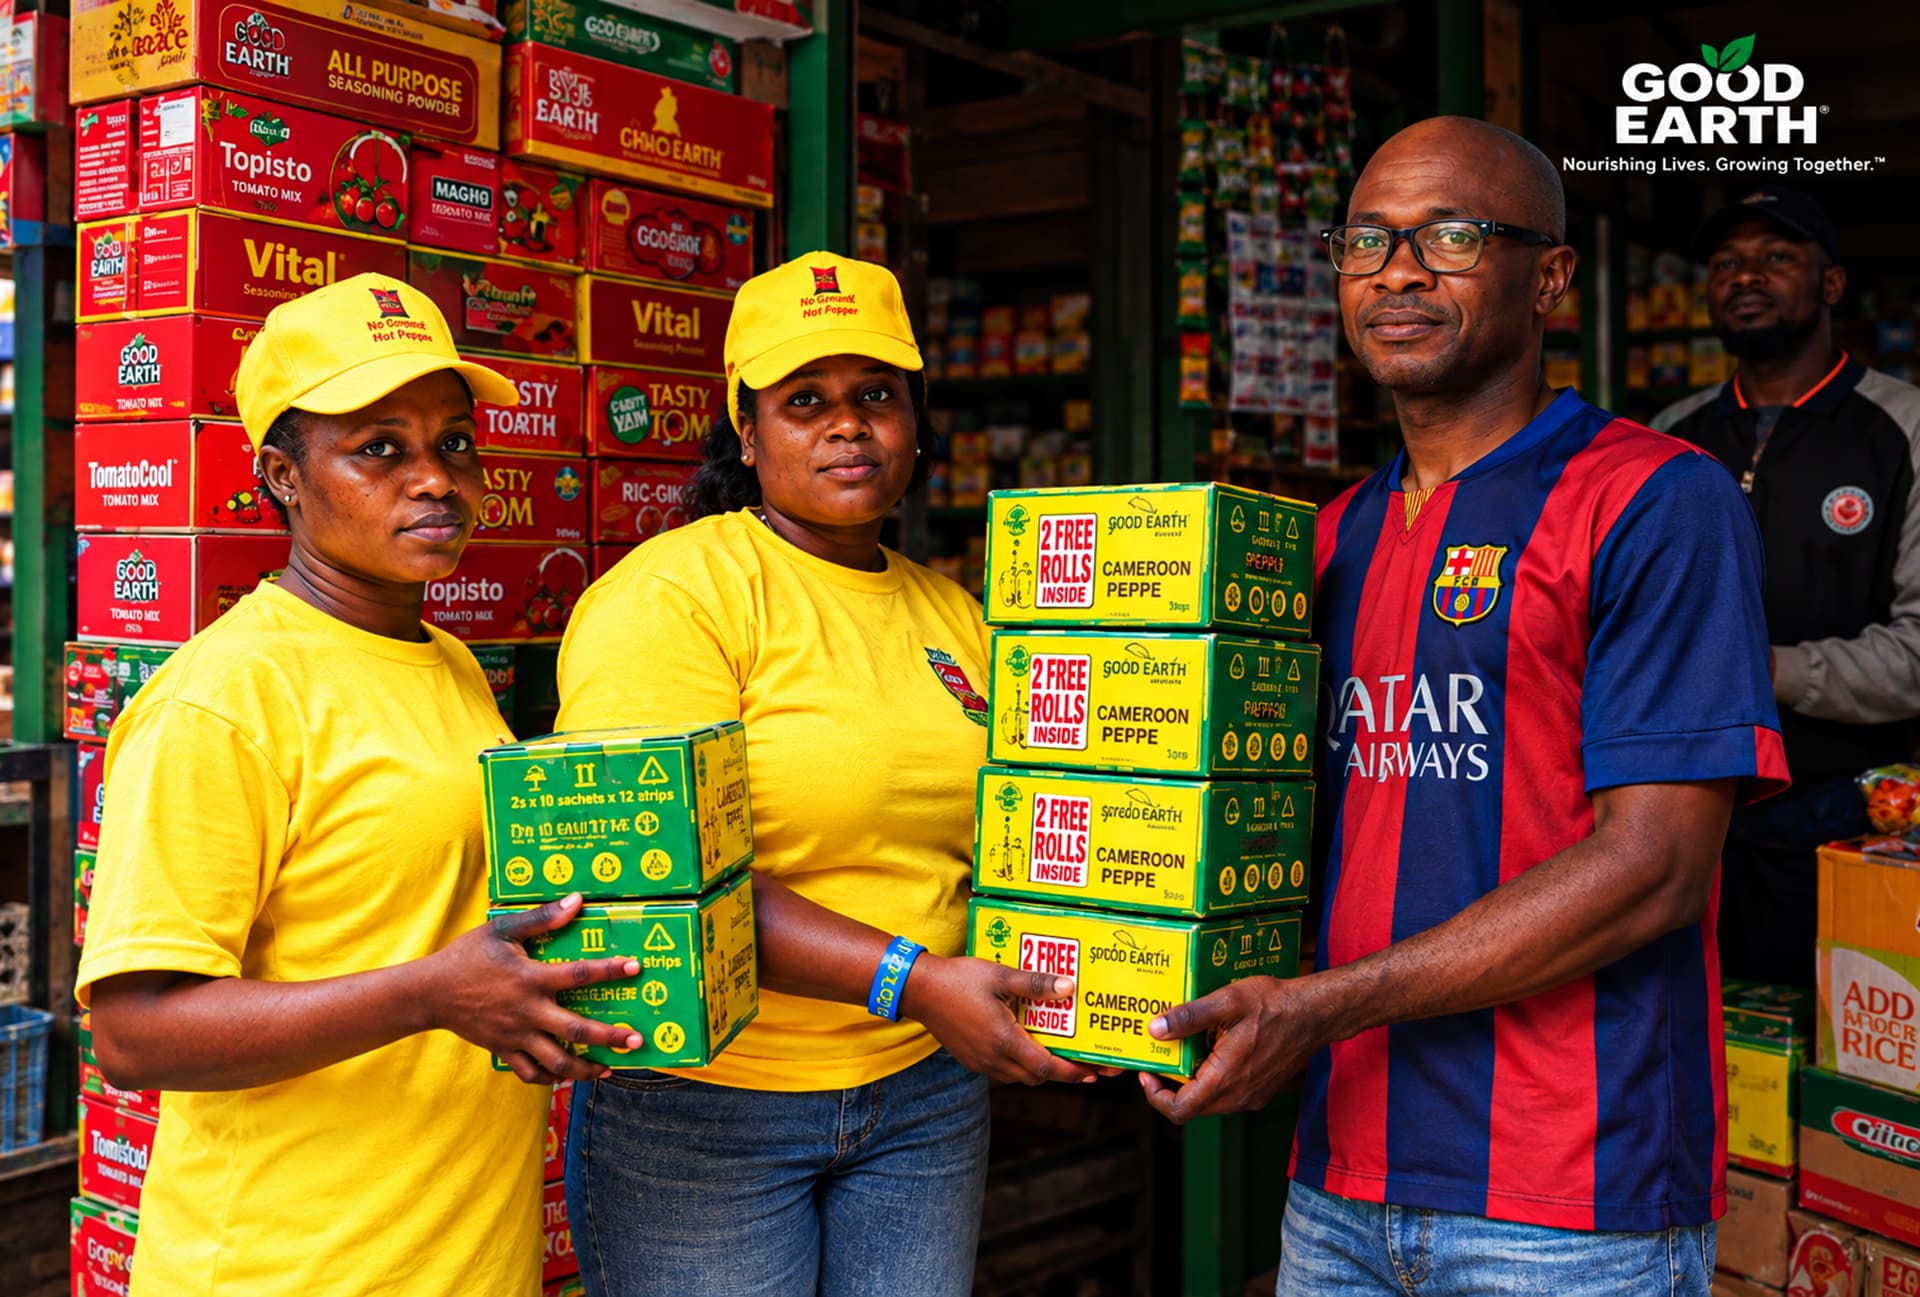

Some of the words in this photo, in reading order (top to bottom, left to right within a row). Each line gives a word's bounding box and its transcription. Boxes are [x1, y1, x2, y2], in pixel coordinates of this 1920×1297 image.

[225, 42, 290, 77] EARTH
[327, 49, 366, 79] ALL
[372, 60, 462, 102] PURPOSE
[328, 74, 403, 104] SEASONING
[407, 93, 461, 117] POWDER
[535, 98, 598, 135] EARTH
[219, 141, 312, 183] Topisto
[673, 138, 722, 170] EARTH
[232, 180, 279, 199] TOMATO
[281, 189, 302, 203] MIX
[367, 320, 384, 331] No
[631, 299, 700, 340] Vital
[373, 331, 395, 342] Hot
[120, 344, 158, 366] GOOD
[118, 364, 160, 385] EARTH
[116, 398, 146, 410] TOMATO
[510, 380, 558, 409] STY
[648, 383, 711, 410] TASTY
[649, 409, 711, 443] TOM
[88, 459, 173, 489] TomatoCool
[103, 494, 138, 506] TOMATO
[140, 494, 159, 506] MIX
[479, 493, 534, 528] OM
[1146, 513, 1187, 529] EARTH
[1041, 520, 1053, 551] 2
[1055, 518, 1093, 551] FREE
[116, 559, 156, 581] GOOD
[1040, 553, 1091, 583] ROLLS
[1103, 561, 1191, 577] CAMEROON
[114, 581, 159, 601] EARTH
[1042, 586, 1086, 603] INSIDE
[1107, 582, 1162, 598] PEPPE
[110, 608, 143, 620] TOMATO
[145, 609, 160, 622] MIX
[432, 611, 473, 622] TOMATO
[1032, 658, 1043, 690] 2
[1047, 658, 1087, 691] FREE
[1144, 661, 1187, 676] EARTH
[1031, 693, 1085, 725] ROLLS
[1097, 705, 1189, 724] CAMEROON
[1033, 726, 1080, 745] INSIDE
[1102, 727, 1158, 744] PEPPE
[1344, 742, 1489, 782] AIRWAYS
[511, 796, 527, 809] 2s
[529, 798, 537, 808] x
[540, 794, 554, 807] 10
[557, 793, 605, 806] sachets
[607, 793, 616, 803] x
[619, 790, 634, 803] 12
[1035, 798, 1046, 828] 2
[1050, 799, 1089, 832] FREE
[1142, 806, 1183, 823] EARTH
[1034, 832, 1086, 863] ROLLS
[1096, 847, 1185, 869] CAMEROON
[1036, 863, 1081, 883] INSIDE
[1101, 868, 1156, 888] PEPPE
[643, 955, 682, 970] strips
[1023, 939, 1034, 971] 2
[1037, 941, 1076, 977] FREE
[1130, 950, 1170, 968] EARTH
[1085, 991, 1172, 1016] CAMEROON
[1842, 980, 1914, 1021] ADD
[1024, 1010, 1068, 1031] INSIDE
[1090, 1013, 1143, 1036] PEPPE
[1842, 1027, 1916, 1071] RICE
